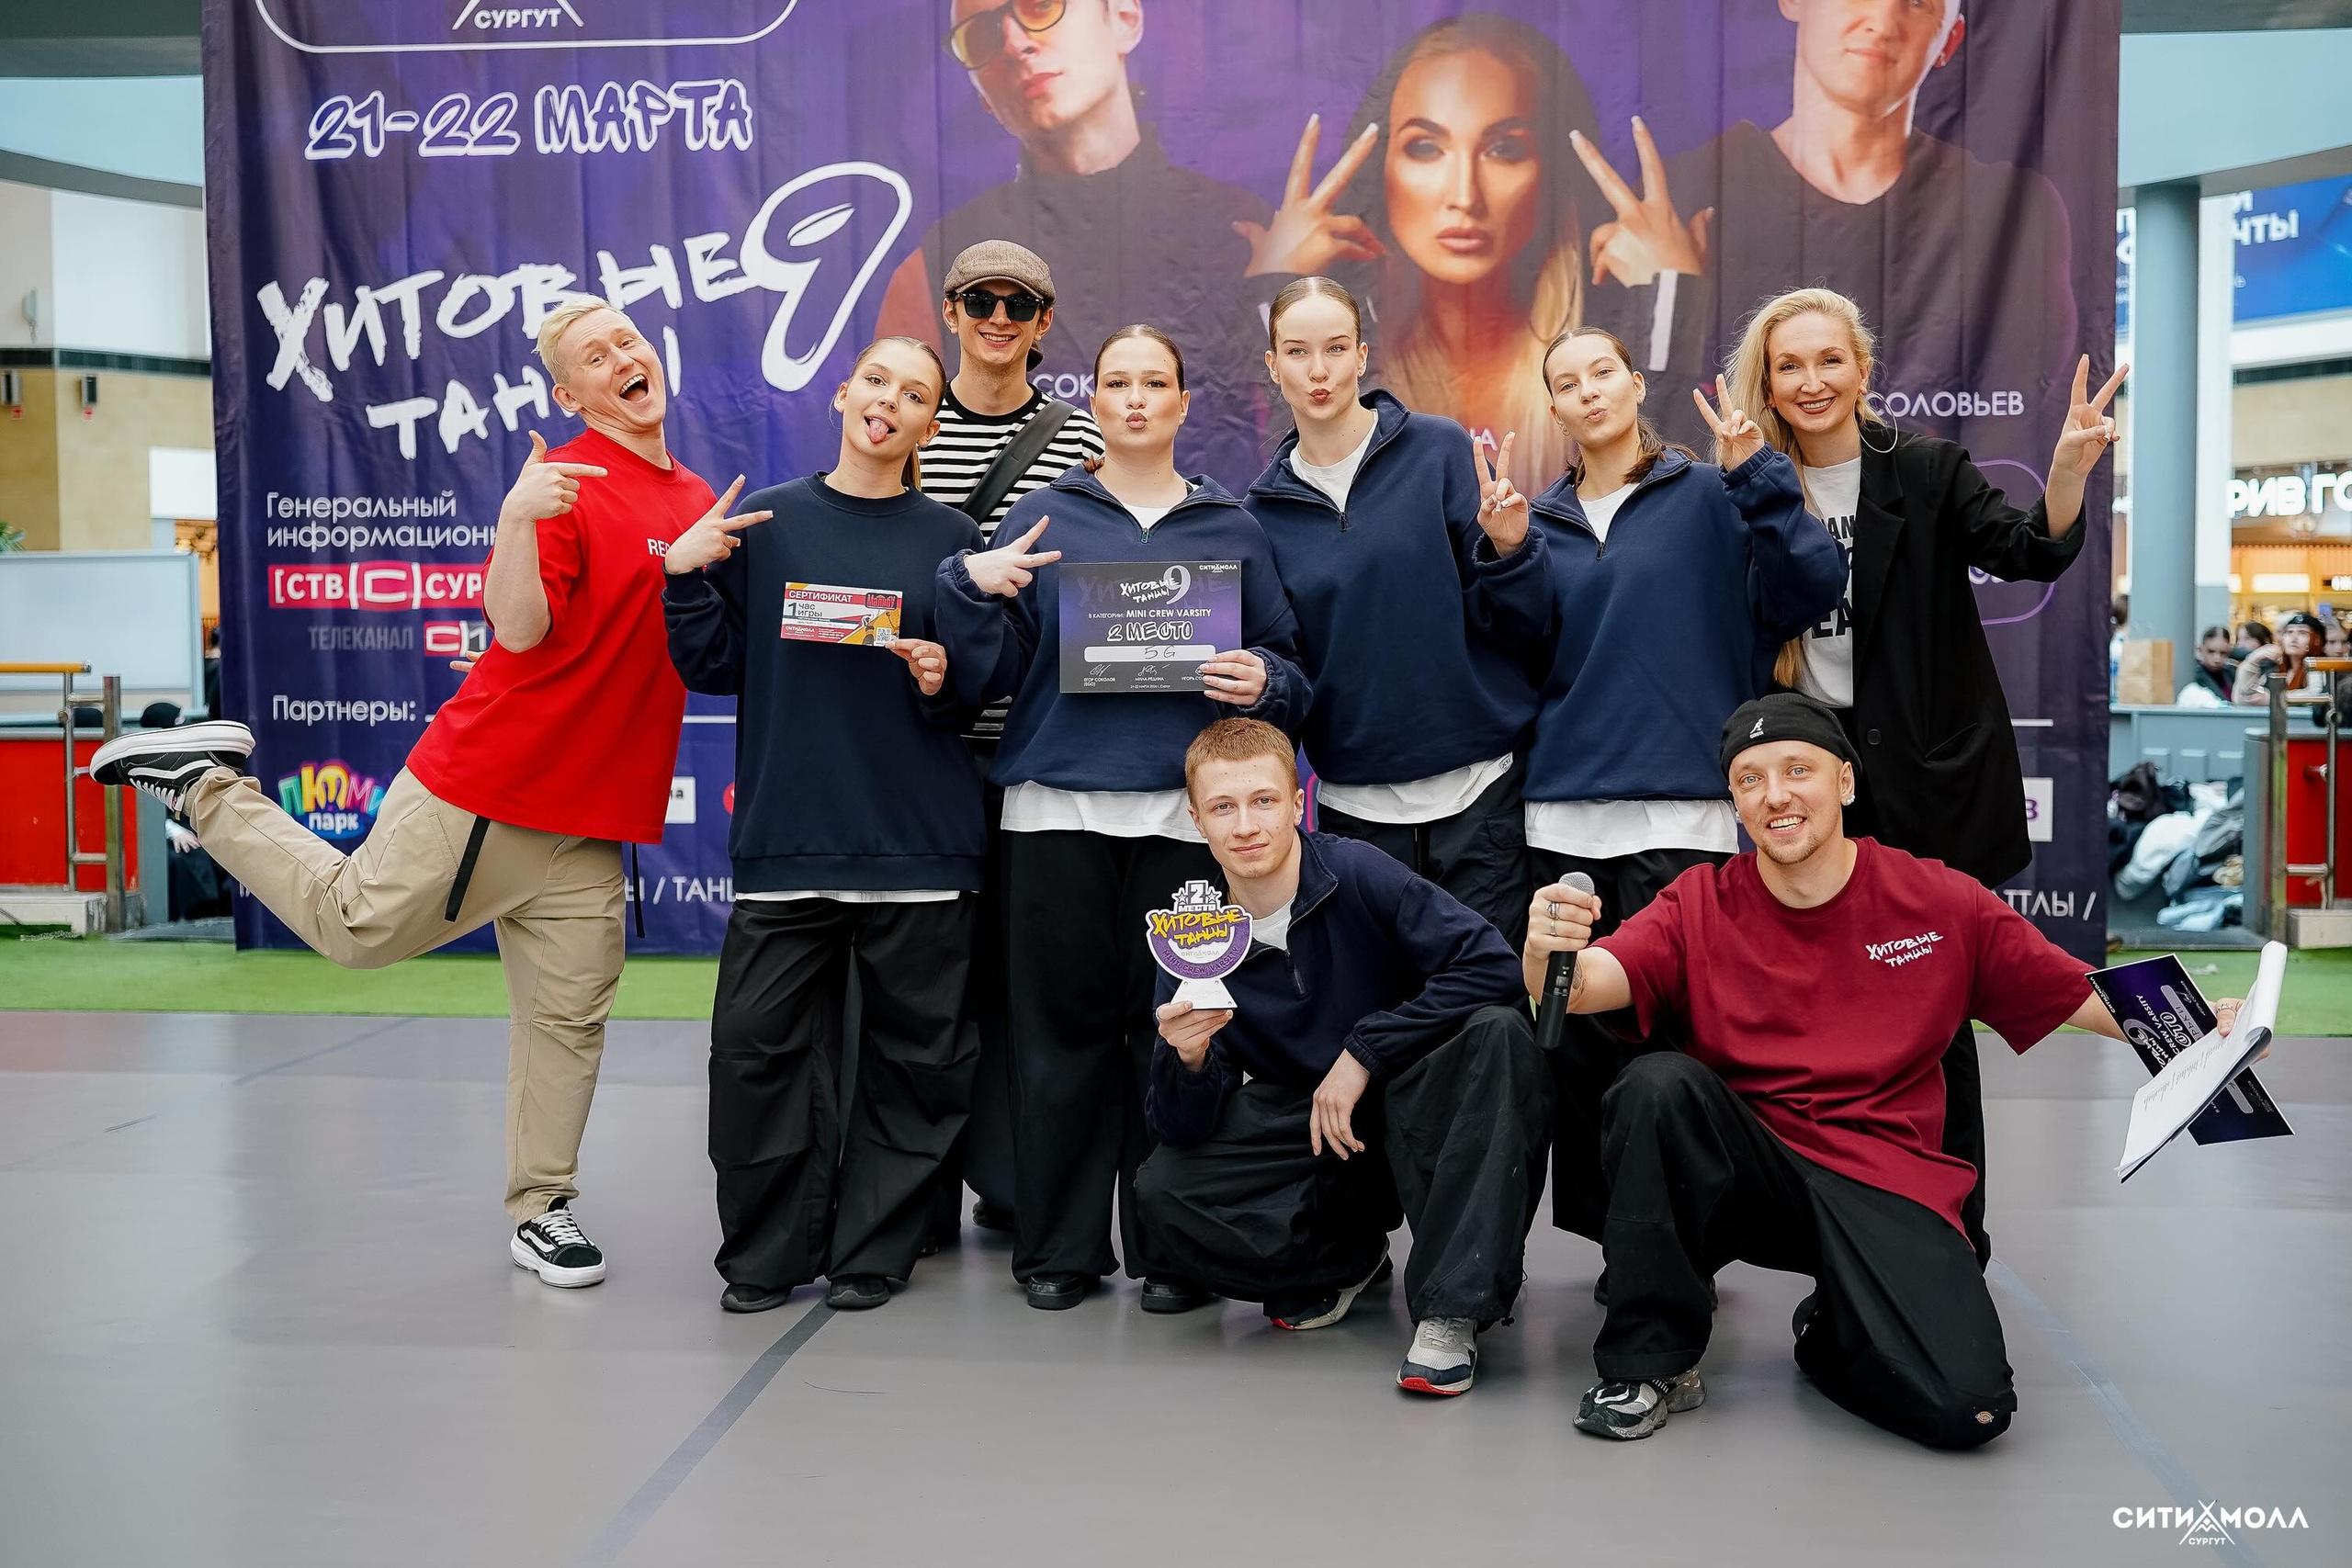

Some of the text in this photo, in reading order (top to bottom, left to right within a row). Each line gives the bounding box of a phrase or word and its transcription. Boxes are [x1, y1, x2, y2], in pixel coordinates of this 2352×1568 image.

[473, 8, 562, 29] СУРГУТ
[305, 79, 754, 160] 21-22 МАРТА
[2233, 209, 2299, 245] ЧТЫ
[257, 231, 747, 402] ХИТОВЫЕ
[1033, 373, 1095, 399] СОК
[1865, 390, 2025, 418] СОЛОВЬЕВ
[2312, 470, 2352, 514] ГО
[266, 490, 457, 524] Генеральный
[788, 591, 853, 603] СЕРТИФИКАТ
[1120, 577, 1180, 597] ХИТОВЫЕ
[1133, 588, 1170, 604] ТАНЦЫ
[787, 602, 797, 616] 1
[797, 610, 822, 618] игры
[1126, 610, 1146, 618] MINI
[1176, 608, 1212, 617] VARSITY
[308, 626, 414, 650] ТЕЛЕКАНАЛ
[1107, 621, 1193, 641] 2 МЕСТО
[273, 694, 416, 727] Партнеры:
[309, 812, 359, 835] парк
[1190, 884, 1204, 904] 2
[1992, 889, 2075, 917] ТТЛЫ
[1151, 908, 1247, 938] ХИТОВЫЕ
[1174, 924, 1228, 946] ТАНЦЫ
[1865, 931, 1944, 961] ХИТОВЫЕ
[1884, 944, 1933, 967] ТАНЦЫ
[1182, 964, 1205, 974] CREW
[1209, 947, 1239, 973] VARSITY
[2136, 995, 2163, 1029] VARSITY
[2137, 1028, 2166, 1068] ОВЫЕ
